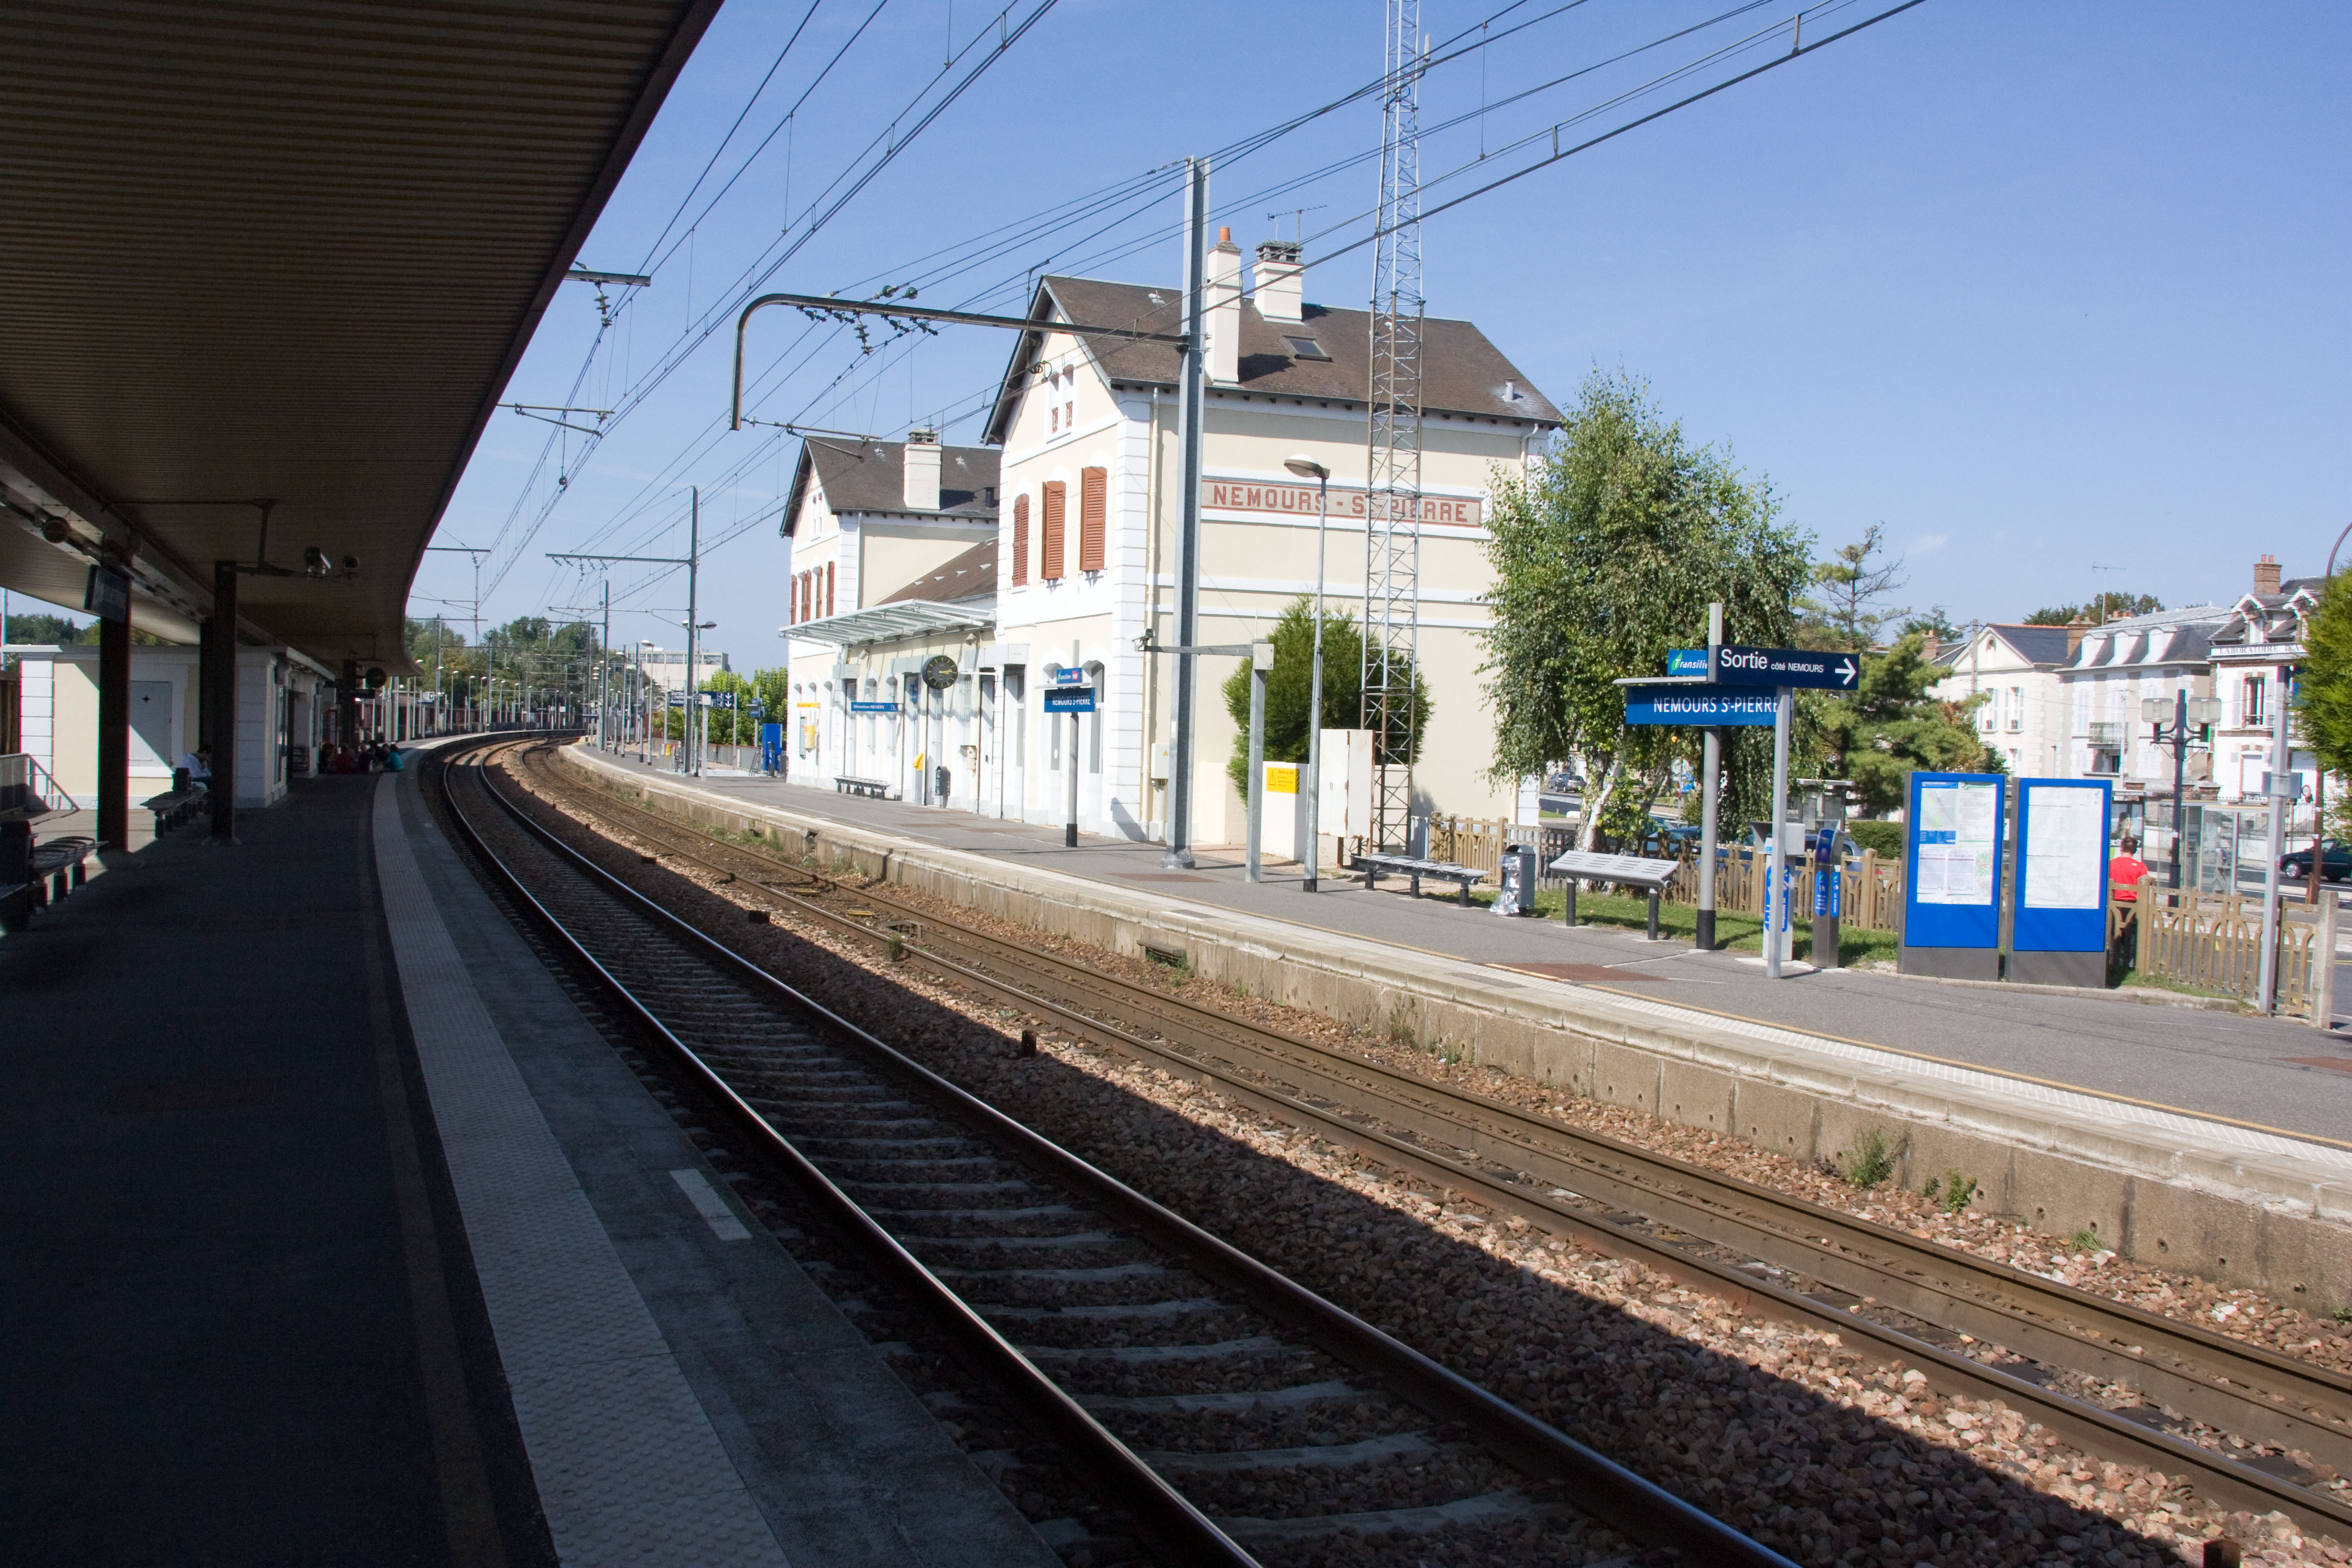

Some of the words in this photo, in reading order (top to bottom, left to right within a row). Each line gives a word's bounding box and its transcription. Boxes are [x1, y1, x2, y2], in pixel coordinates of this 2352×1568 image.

[1213, 485, 1327, 511] NEMOURS
[2220, 645, 2278, 655] LABORATOIRE
[1721, 649, 1767, 669] Sortie
[1771, 662, 1785, 671] côté
[1788, 662, 1823, 673] NEMOURS
[1654, 697, 1717, 712] NEMOURS
